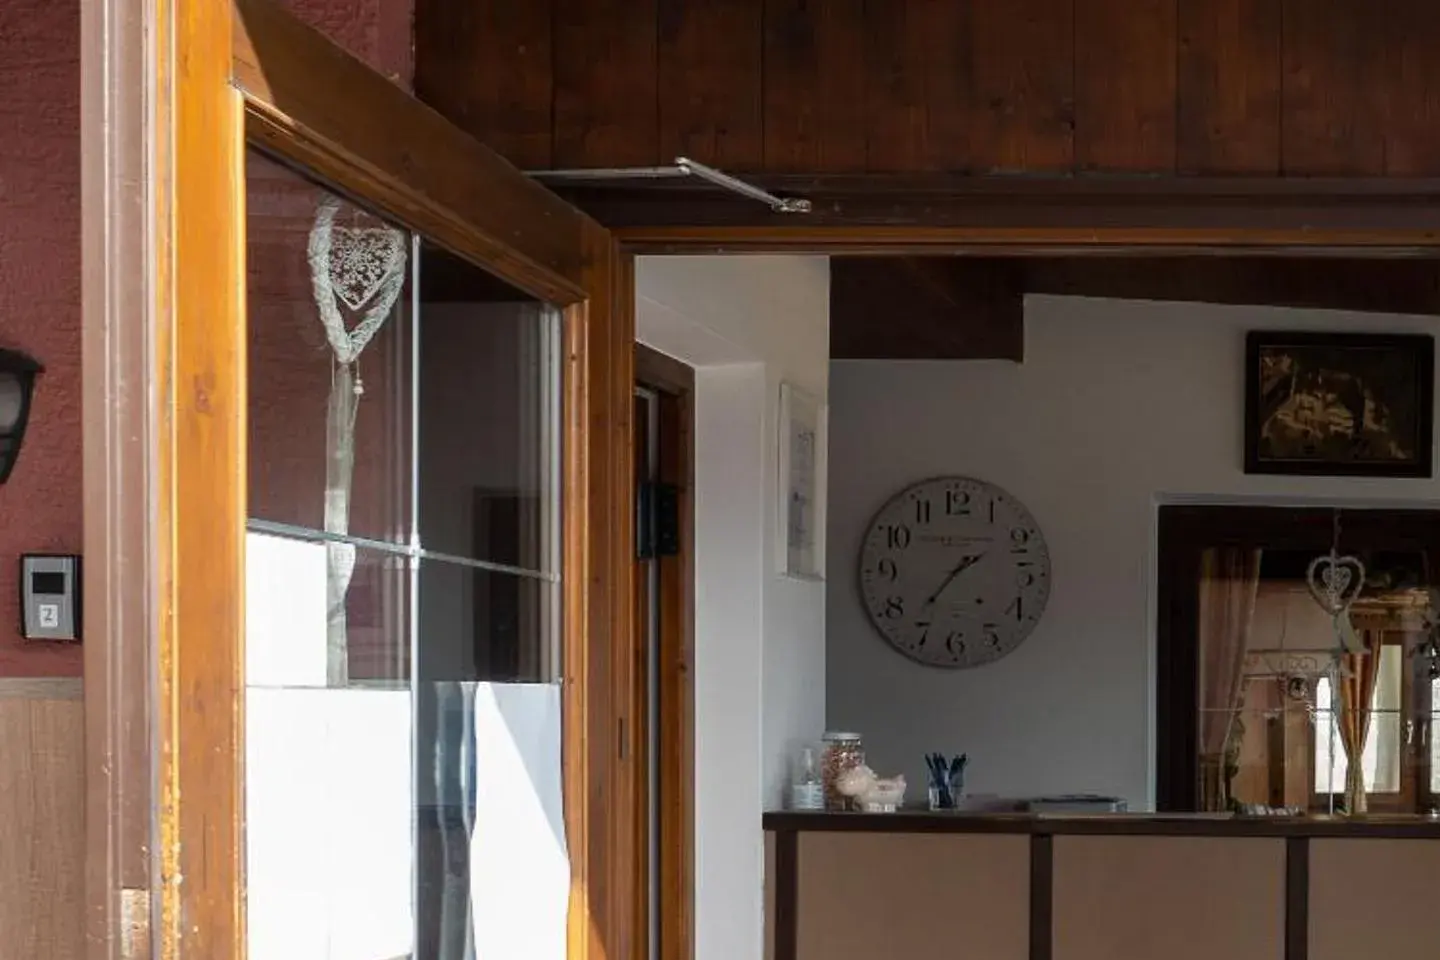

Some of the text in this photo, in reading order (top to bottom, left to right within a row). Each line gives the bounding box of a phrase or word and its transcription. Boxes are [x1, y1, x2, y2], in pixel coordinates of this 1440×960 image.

[916, 499, 930, 523] 11
[946, 490, 970, 515] 12
[989, 499, 995, 523] 1
[887, 525, 910, 550] 10
[878, 560, 897, 582] 9
[42, 607, 53, 622] 2
[885, 596, 904, 619] 8
[914, 621, 930, 648] 7
[946, 630, 966, 656] 6
